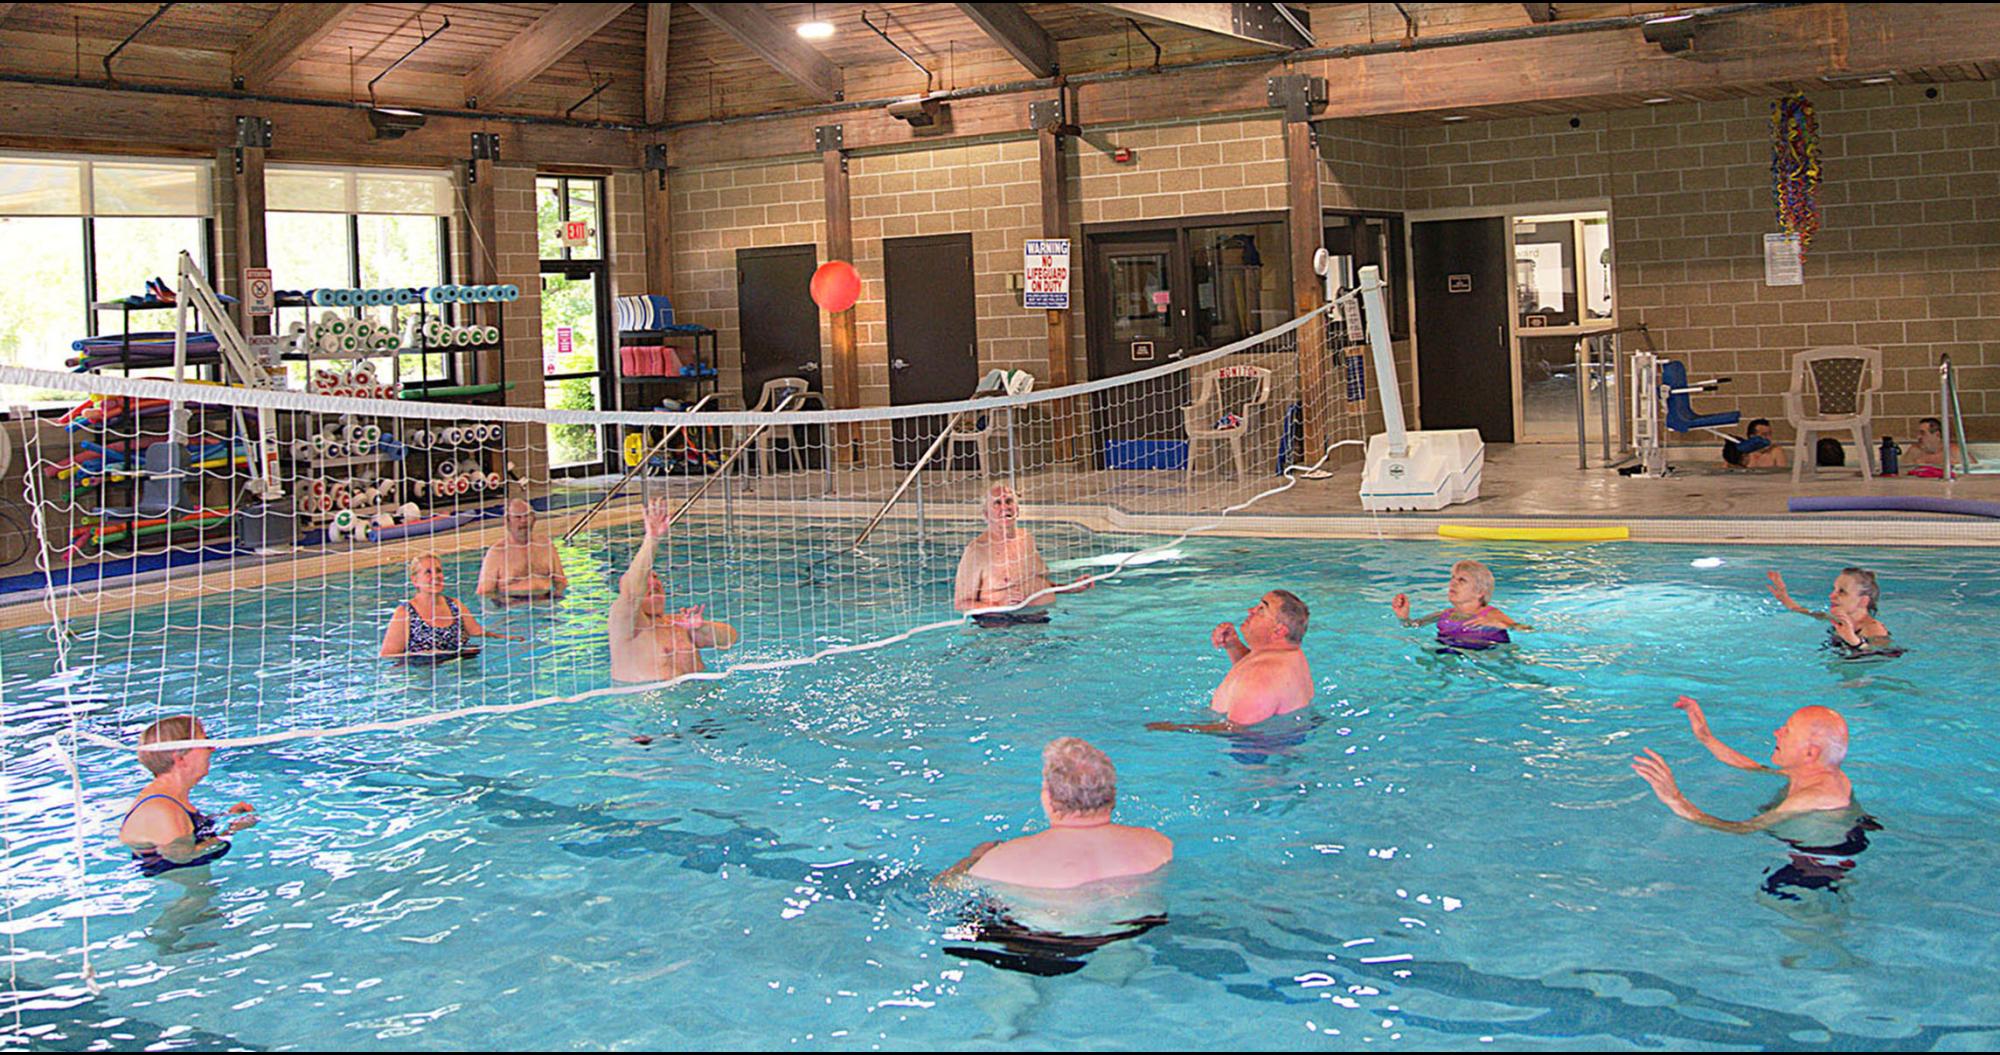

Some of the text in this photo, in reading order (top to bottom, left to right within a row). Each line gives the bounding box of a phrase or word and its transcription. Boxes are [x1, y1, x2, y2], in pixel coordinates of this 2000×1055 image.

[567, 222, 586, 239] EXIT
[1026, 242, 1068, 254] WARNING
[1516, 248, 1539, 258] ard
[1042, 256, 1053, 267] NO
[1027, 268, 1067, 280] LIFEGUARD
[1032, 280, 1062, 292] ON DUTY
